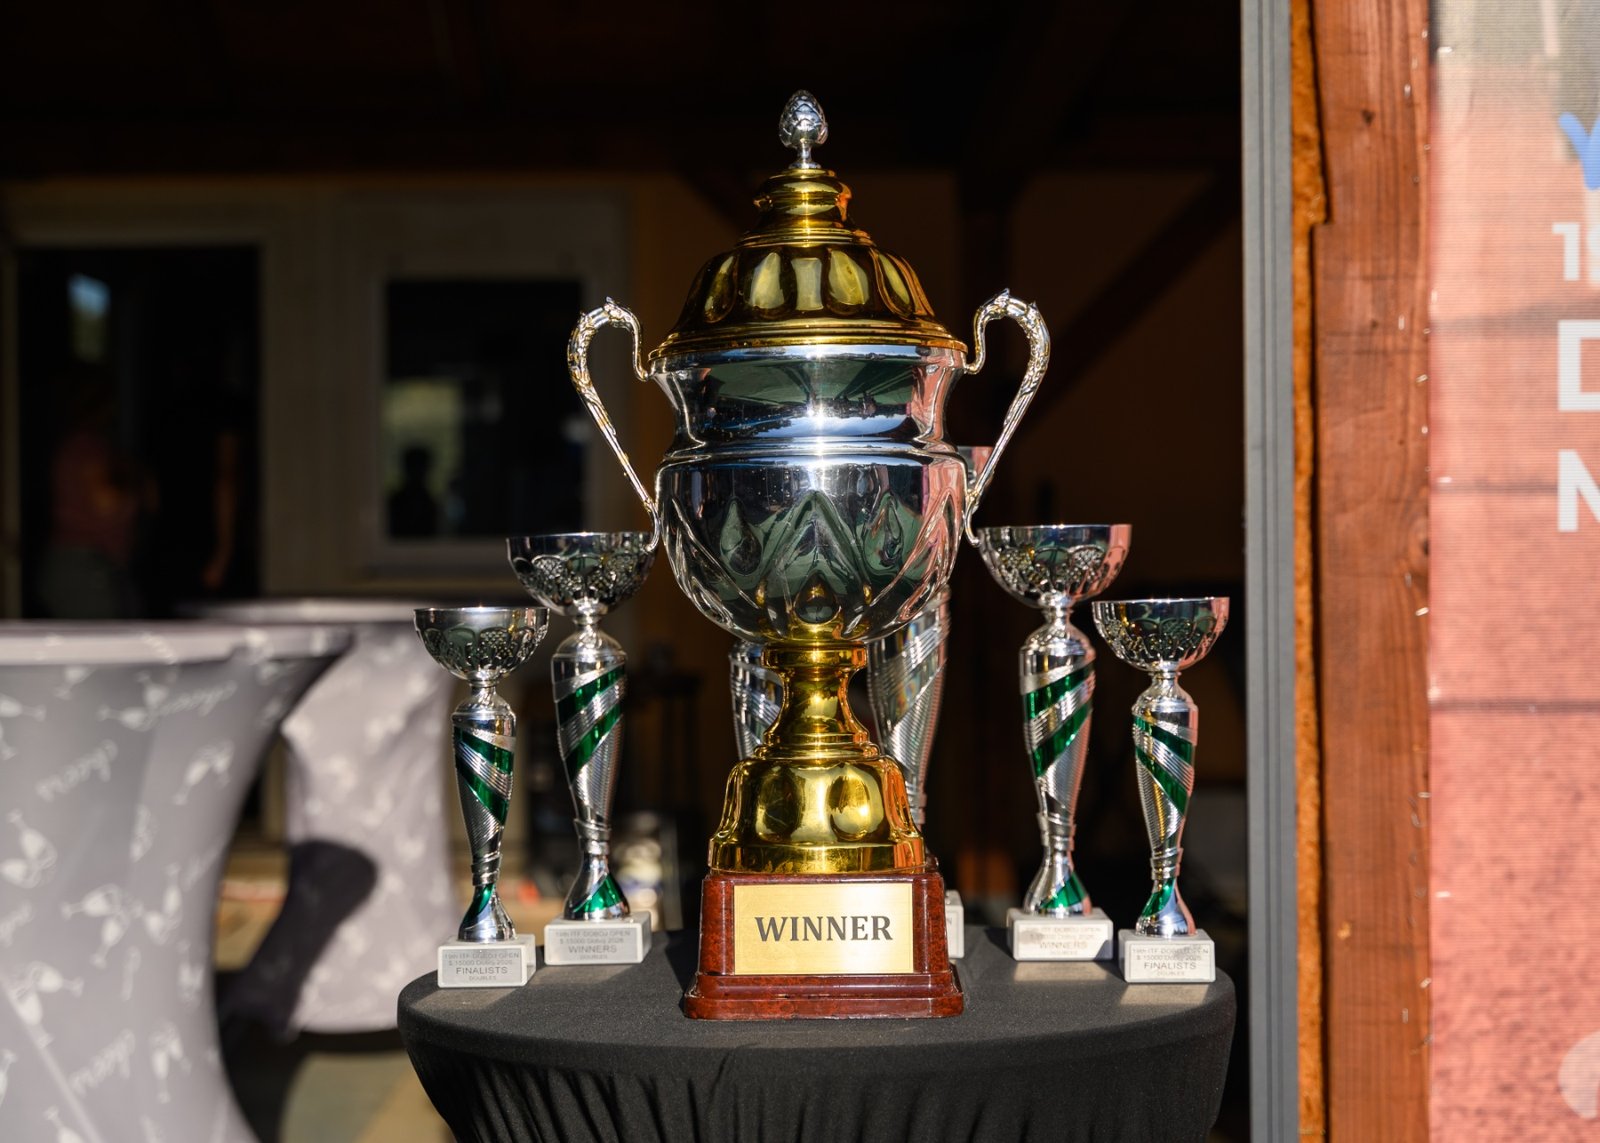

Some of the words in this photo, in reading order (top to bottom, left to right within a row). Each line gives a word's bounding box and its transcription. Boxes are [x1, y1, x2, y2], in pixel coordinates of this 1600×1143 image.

[754, 915, 893, 942] WINNER
[568, 945, 618, 954] WINNERS
[1039, 941, 1088, 949] WINNERS
[499, 951, 520, 959] OPEN
[1143, 961, 1197, 970] FINALISTS
[456, 966, 509, 975] FINALISTS
